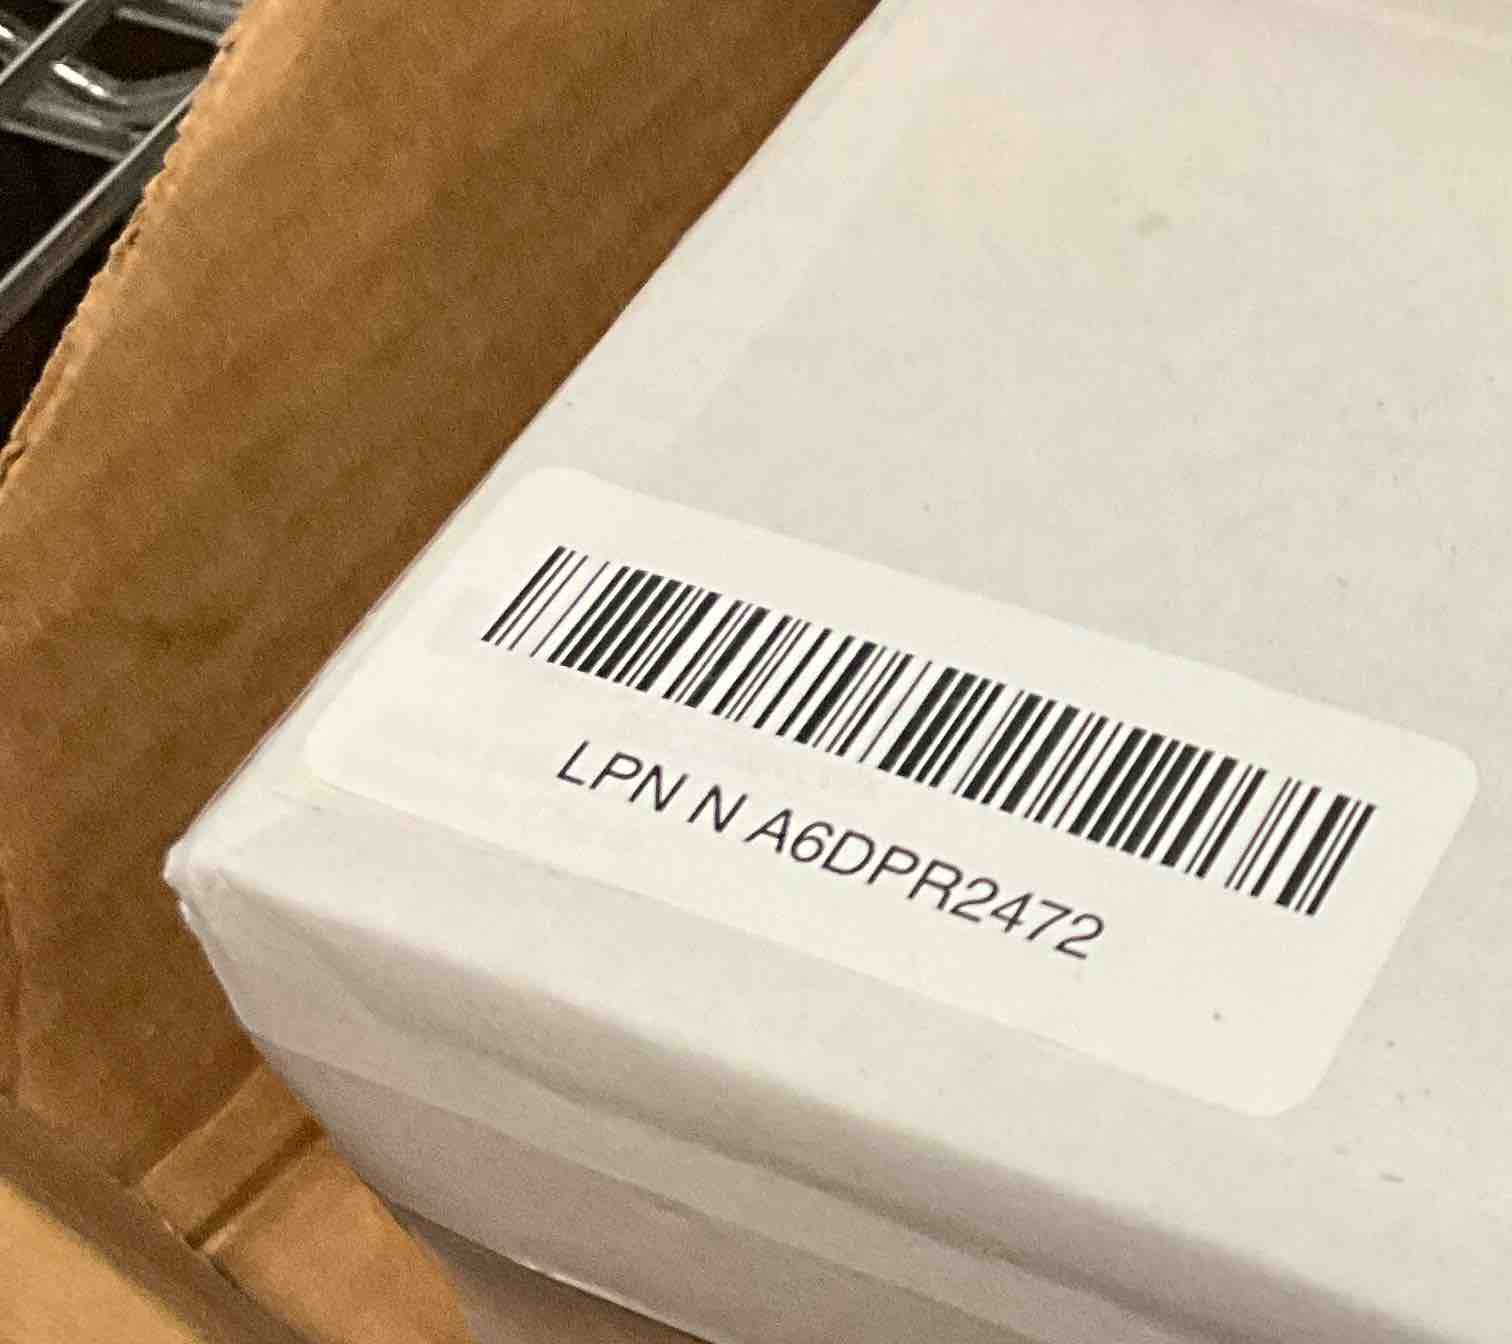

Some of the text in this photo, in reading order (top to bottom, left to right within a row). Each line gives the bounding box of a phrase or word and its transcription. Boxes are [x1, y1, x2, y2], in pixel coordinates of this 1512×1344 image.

[555, 740, 1104, 960] LPN N A6DPR2472
